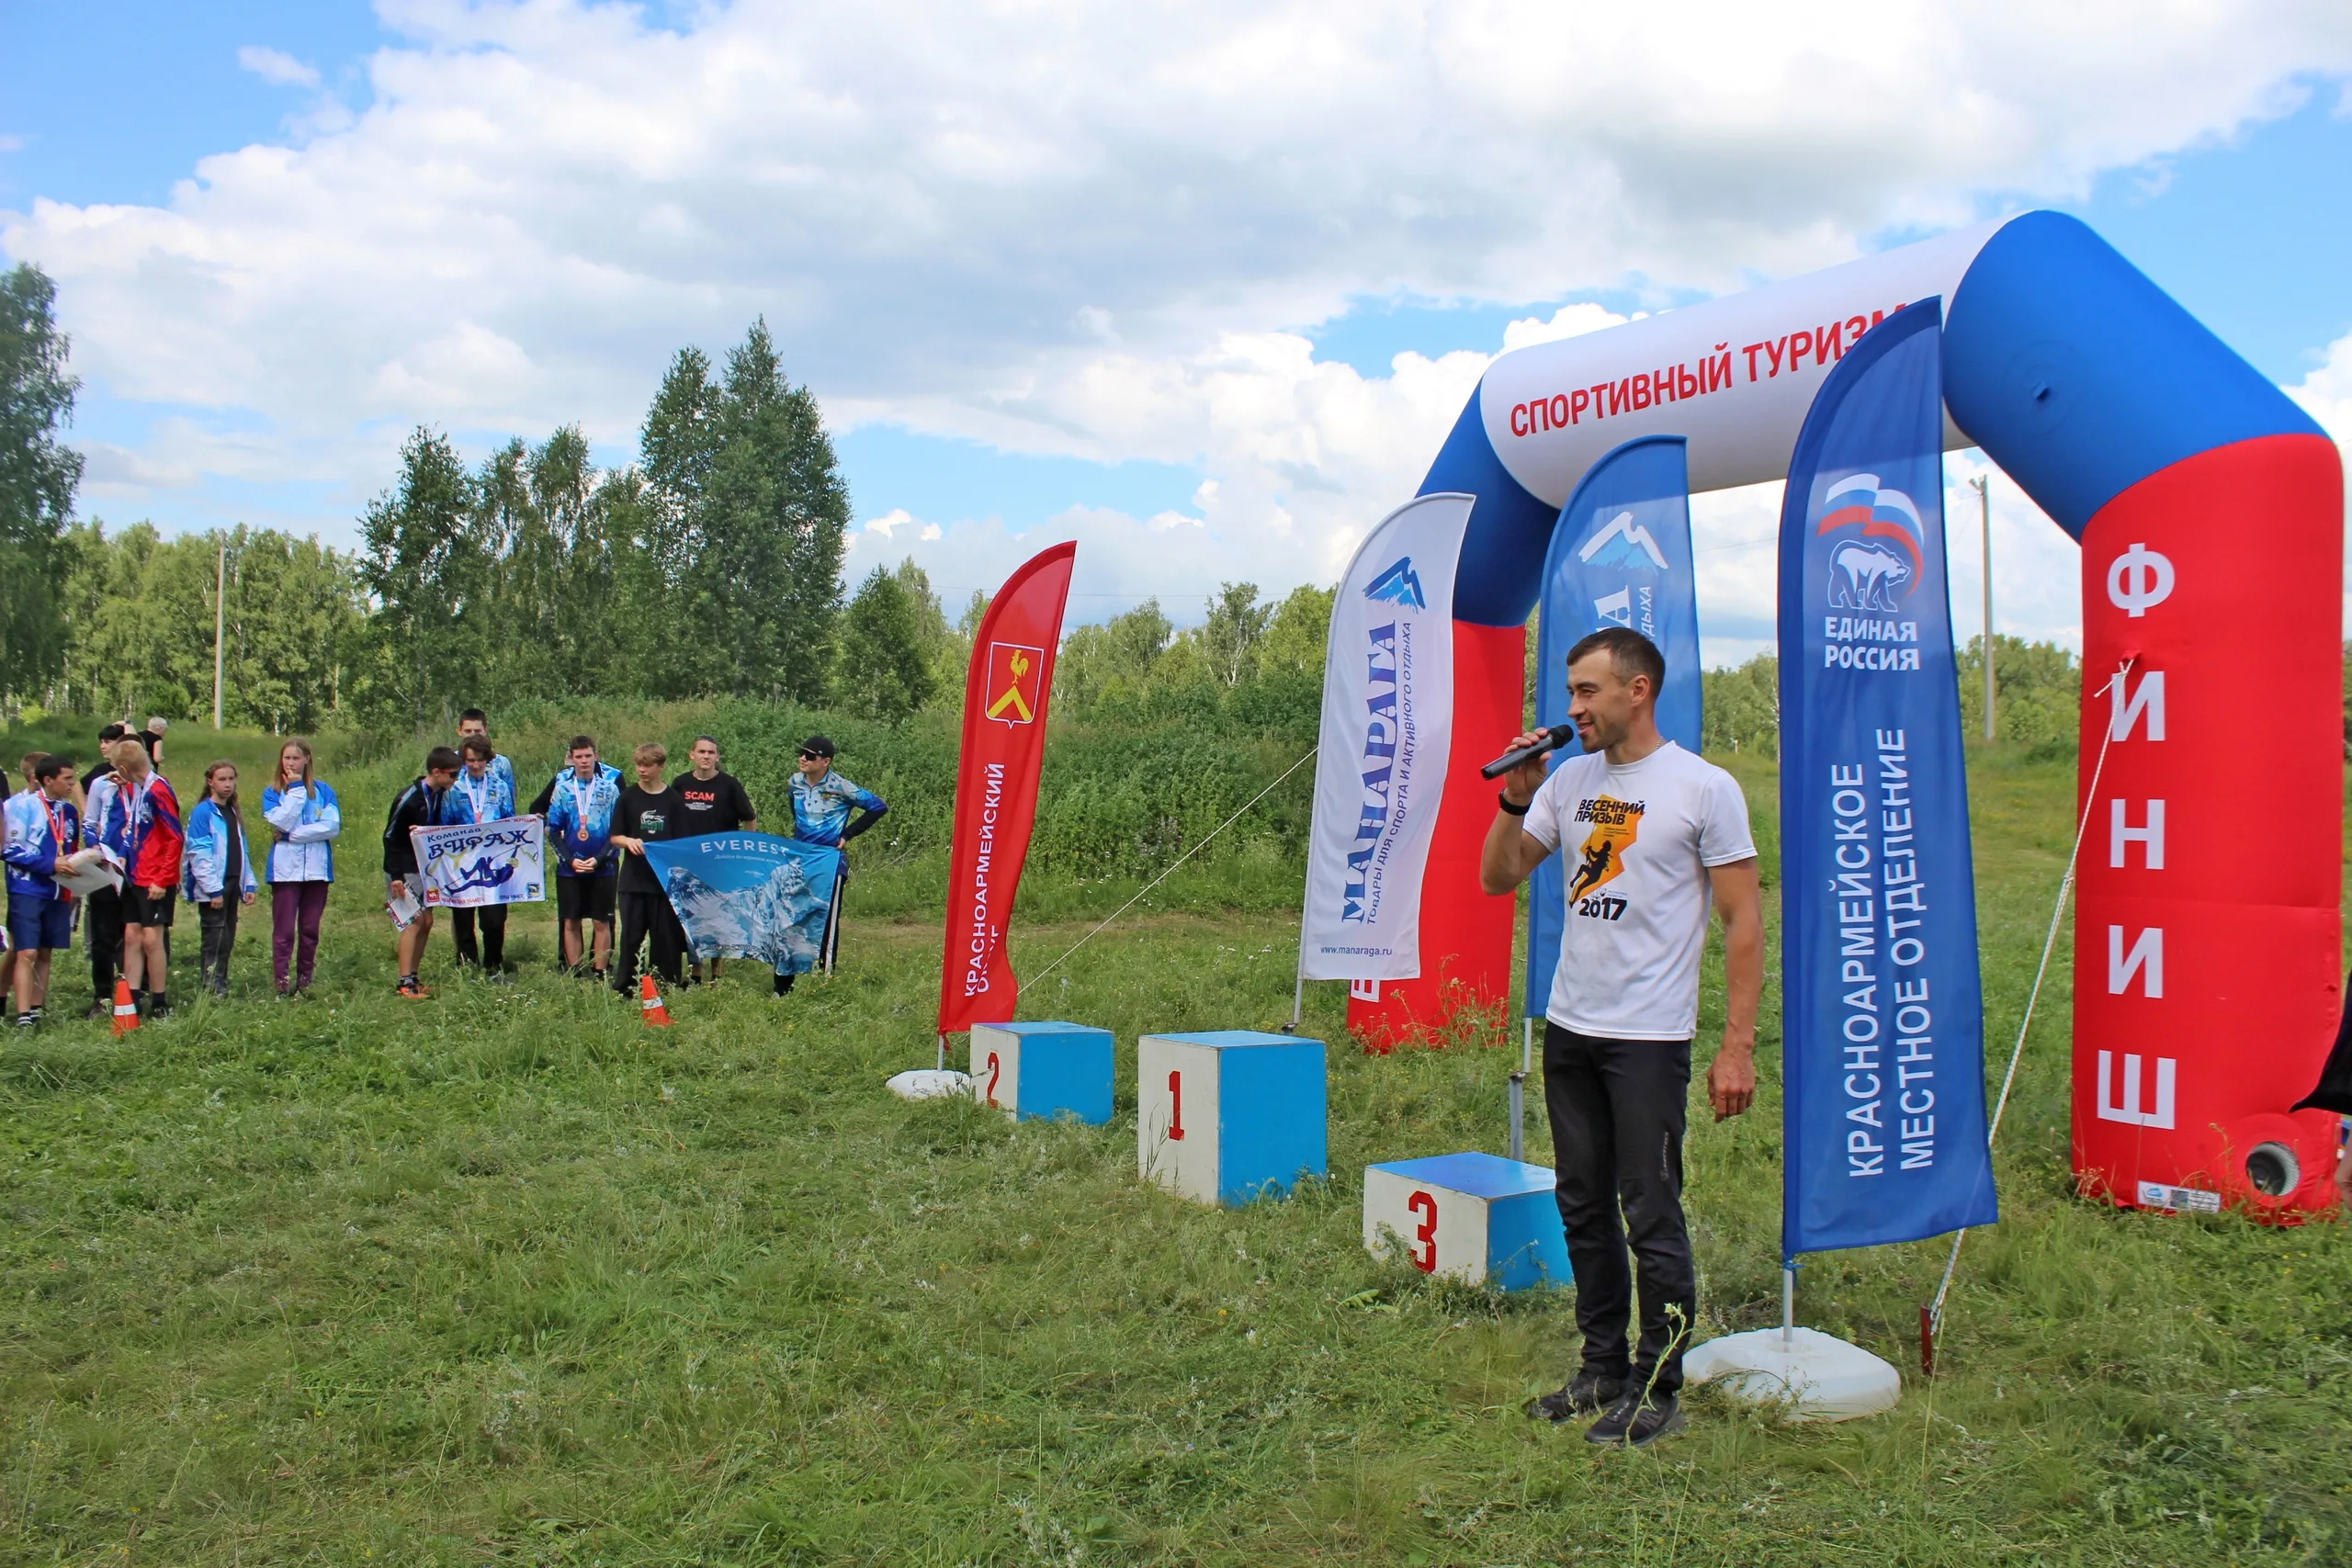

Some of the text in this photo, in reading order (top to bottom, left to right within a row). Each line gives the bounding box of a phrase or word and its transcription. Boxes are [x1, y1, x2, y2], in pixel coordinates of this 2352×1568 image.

[1510, 342, 1733, 437] СПОРТИВНЫЙ
[1639, 586, 1656, 638] ДЫХА
[1825, 616, 1917, 642] ЕДИНАЯ
[1824, 645, 1920, 671] РОССИЯ
[684, 791, 715, 801] SCAM
[1341, 619, 1397, 924] МАНАРАГА
[1367, 622, 1416, 924] ТОВАРЫ ДЛЯ СПОРТА И АКТИВНОГО ОТДЫХА
[1574, 811, 1626, 826] ПРИЗЫВ
[1578, 798, 1646, 814] ВЕСЕННИЙ
[426, 828, 482, 843] Команда
[428, 829, 534, 861] ВИРАЖ
[700, 840, 790, 856] EVEREST
[2097, 543, 2176, 1130] ФИНИШ
[965, 763, 1005, 997] КРАСНОАРМЕЙСКИЙ
[1578, 897, 1628, 921] 2017
[1320, 945, 1393, 957] www.manaraga.ru
[1828, 763, 1883, 1178] КРАСНОАРМЕЙСКОЕ
[1876, 728, 1935, 1171] МЕСТНОЕ ОТДЕЛЕНИЕ
[987, 1052, 1000, 1109] 2
[1169, 1070, 1185, 1141] 1
[1408, 1190, 1438, 1275] 3
